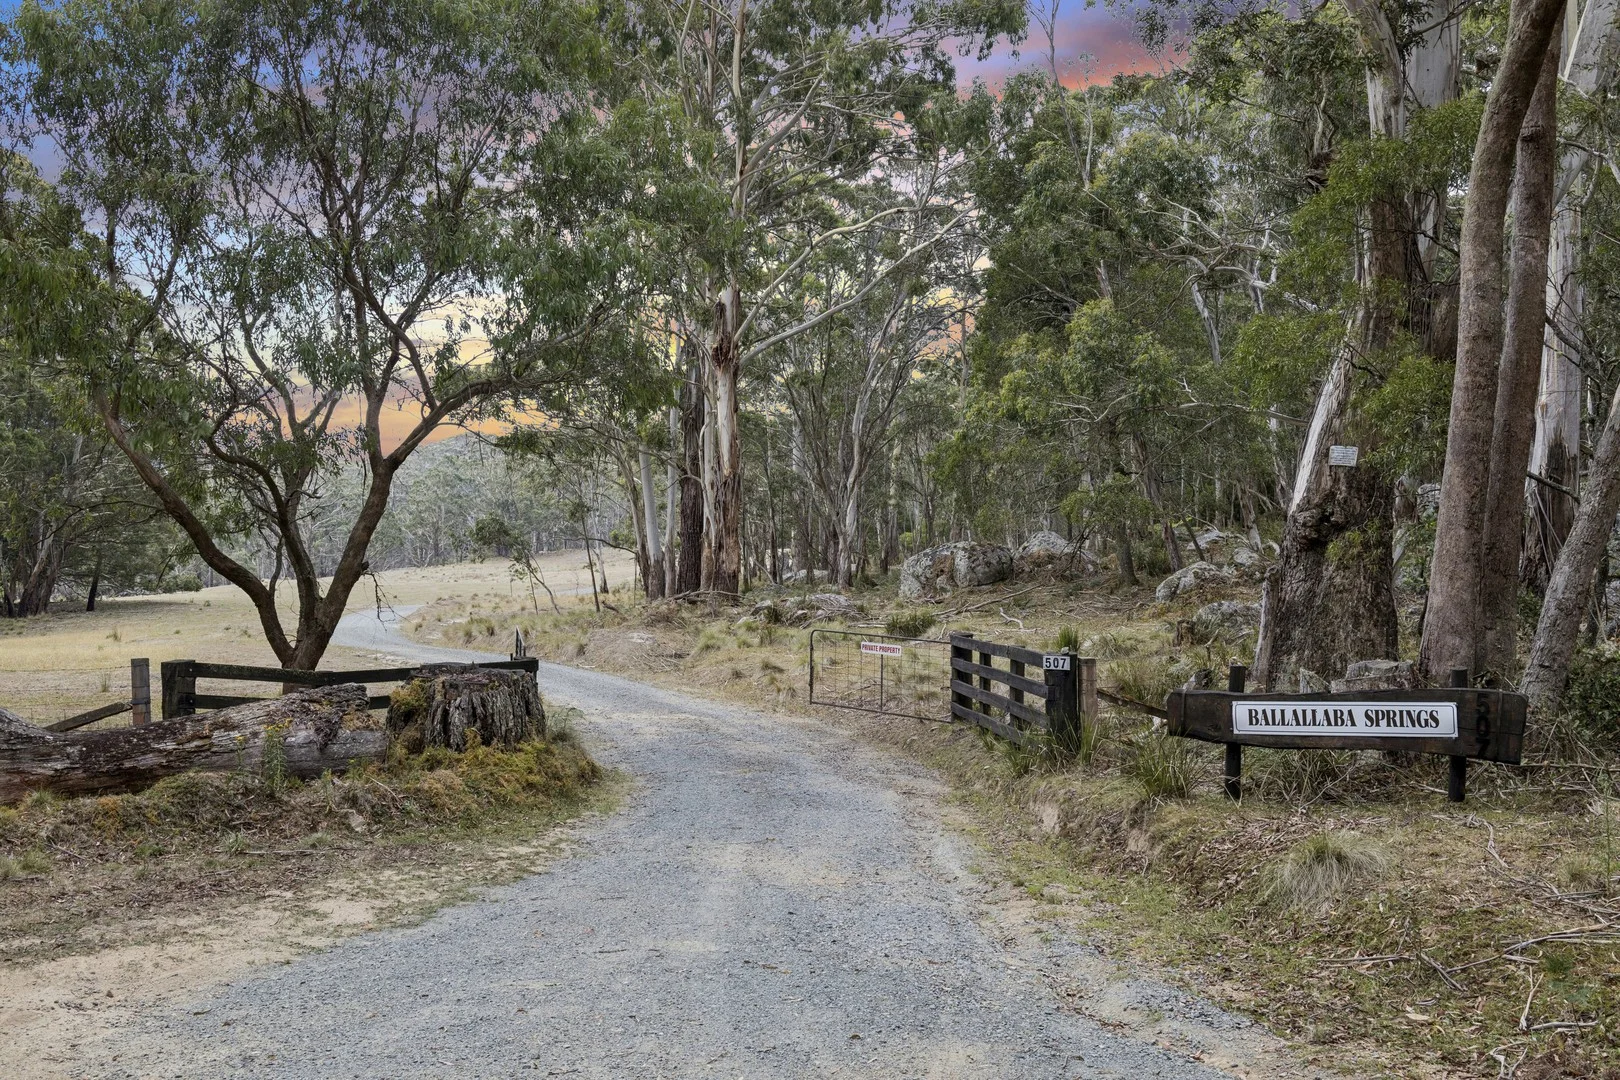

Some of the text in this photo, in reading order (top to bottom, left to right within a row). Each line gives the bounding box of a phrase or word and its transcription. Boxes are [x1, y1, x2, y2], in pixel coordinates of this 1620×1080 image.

[879, 646, 900, 654] PROPERTY
[1045, 657, 1067, 668] 507
[1248, 708, 1440, 729] BALLALLABA SPRINGS
[1476, 692, 1491, 757] 507
